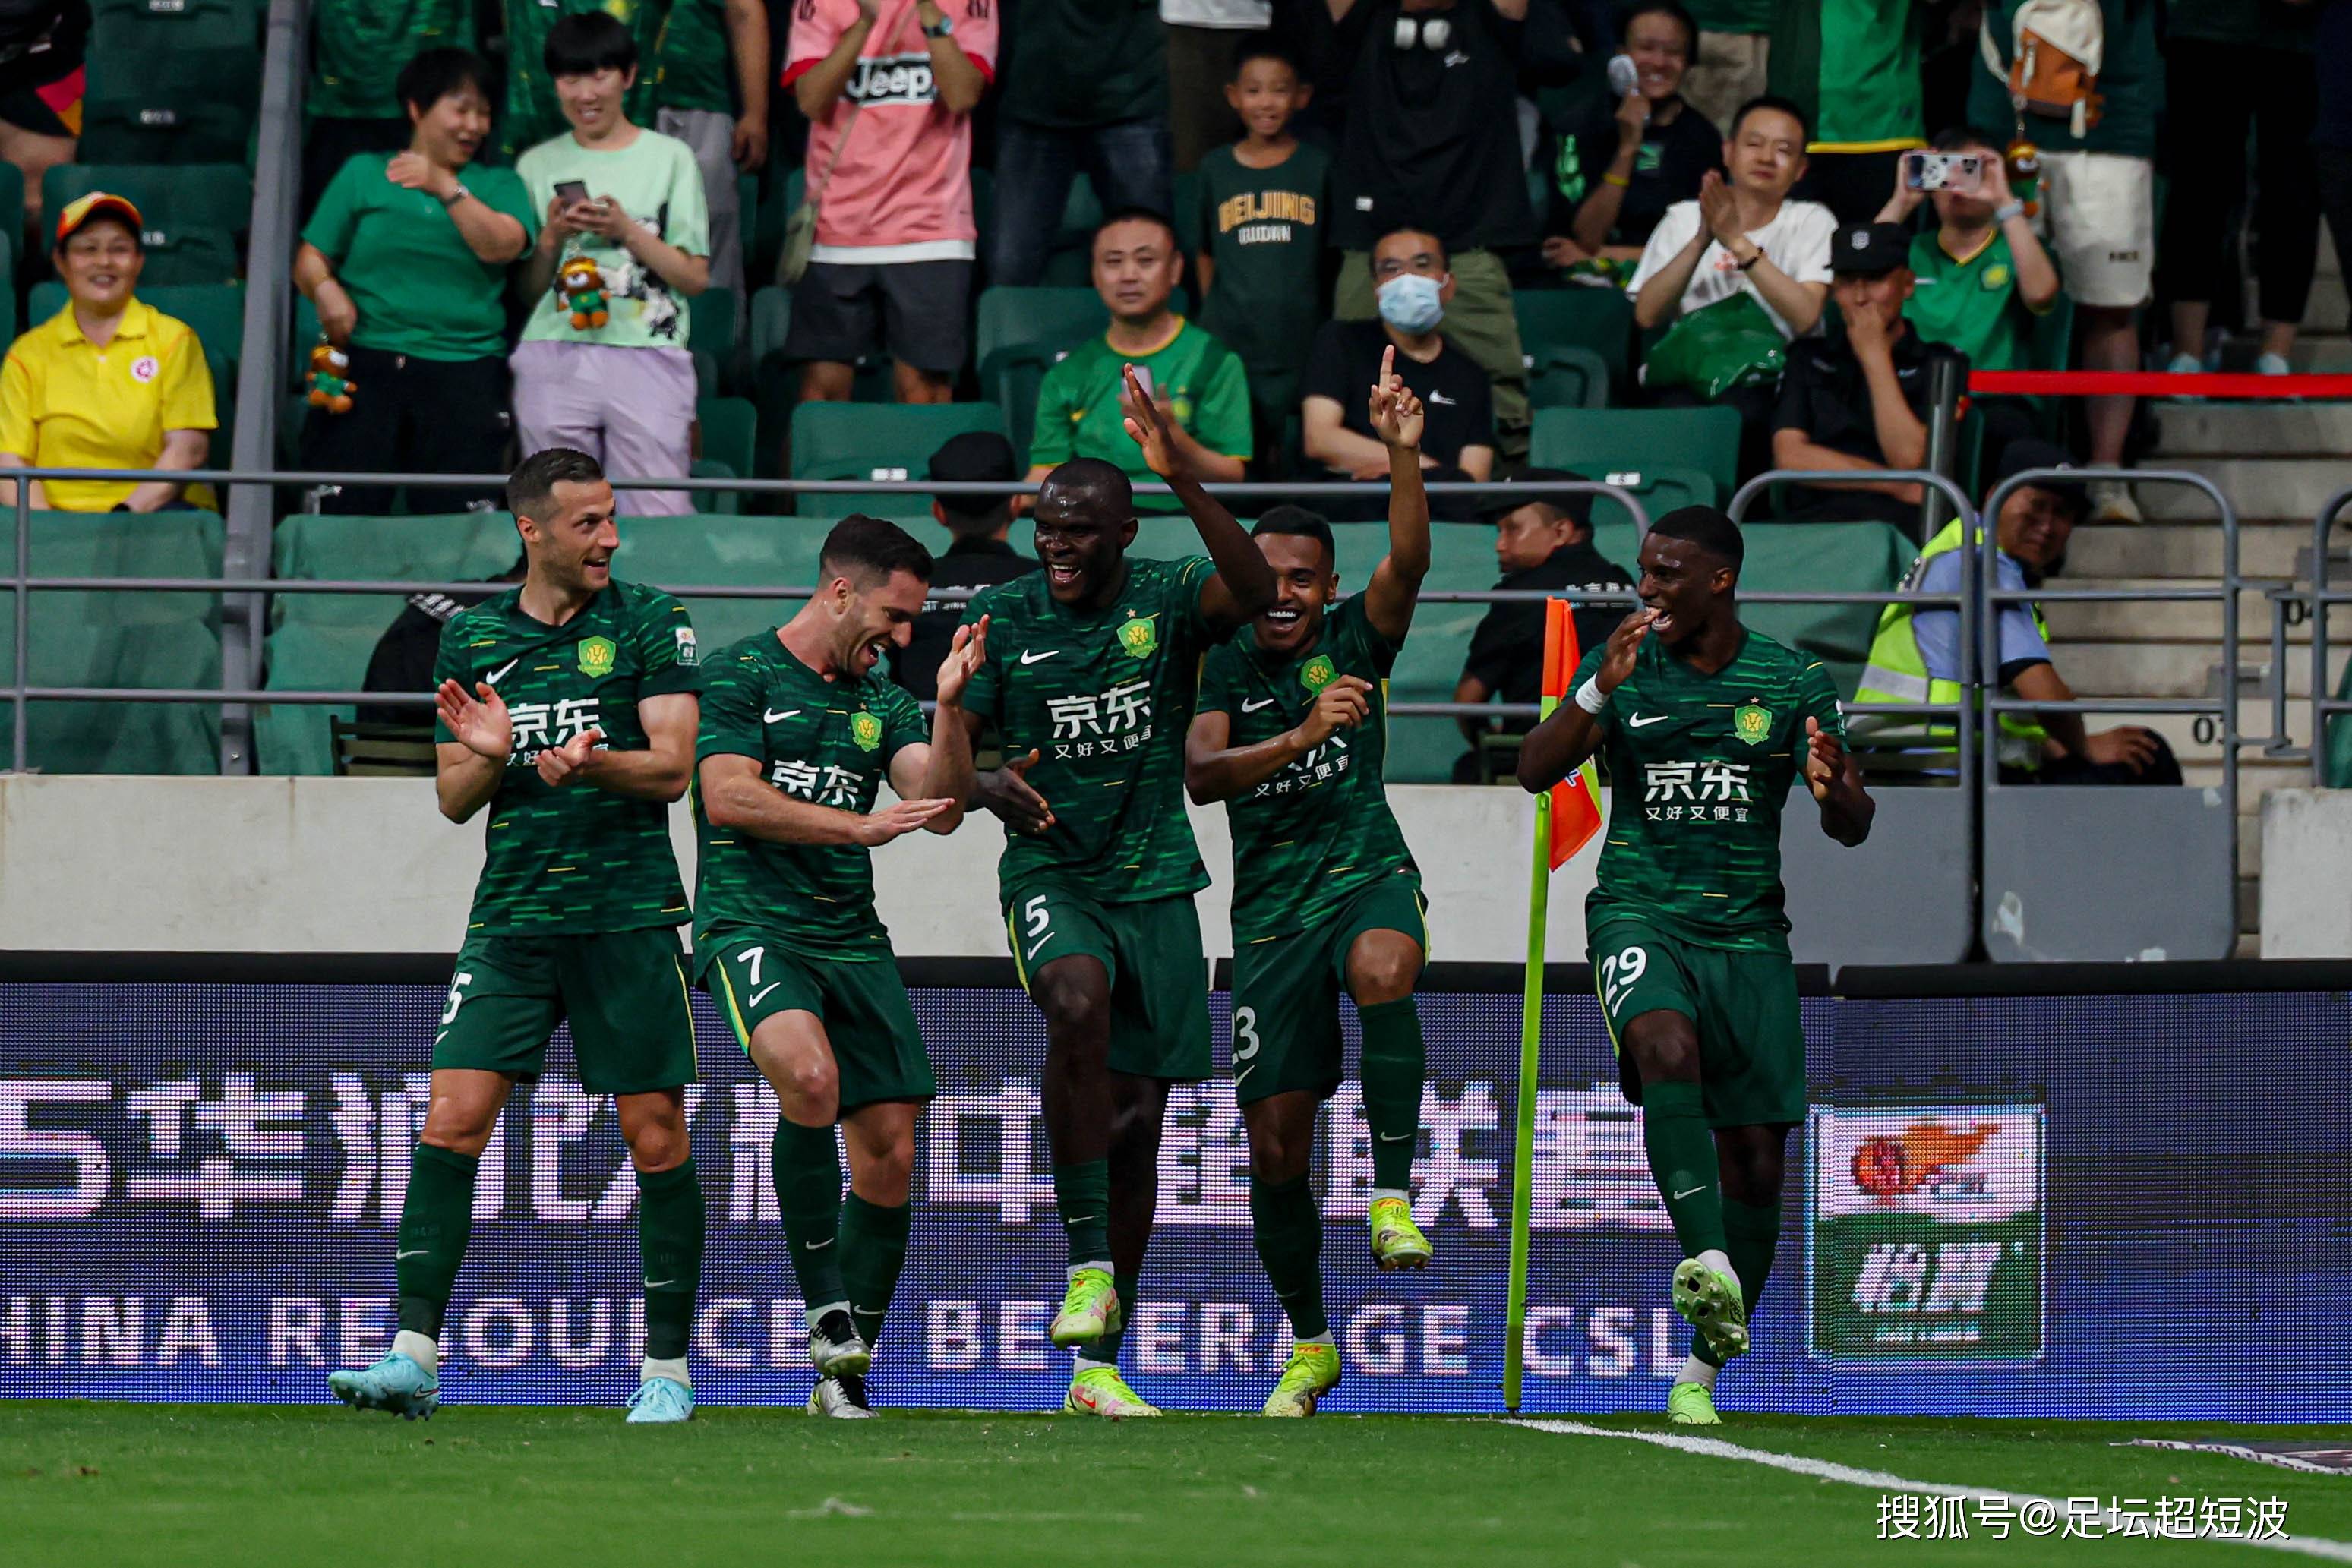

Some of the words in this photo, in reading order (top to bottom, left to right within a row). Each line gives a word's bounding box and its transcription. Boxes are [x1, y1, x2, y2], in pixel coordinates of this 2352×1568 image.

[845, 61, 933, 99] Jeep
[1218, 191, 1315, 233] BEIJING
[507, 698, 608, 749] 京东
[1046, 681, 1151, 739] 京东
[2193, 717, 2224, 744] 0
[772, 759, 863, 810] 京东
[1255, 755, 1349, 797] 又好又便宜
[1644, 760, 1751, 802] 京东
[1645, 806, 1749, 822] 又好又便宜
[1025, 894, 1050, 938] 5
[737, 946, 764, 986] 7
[1602, 946, 1646, 1006] 29
[442, 972, 472, 1024] 5
[1231, 1006, 1260, 1065] 3
[926, 1300, 1469, 1374] BEERGE
